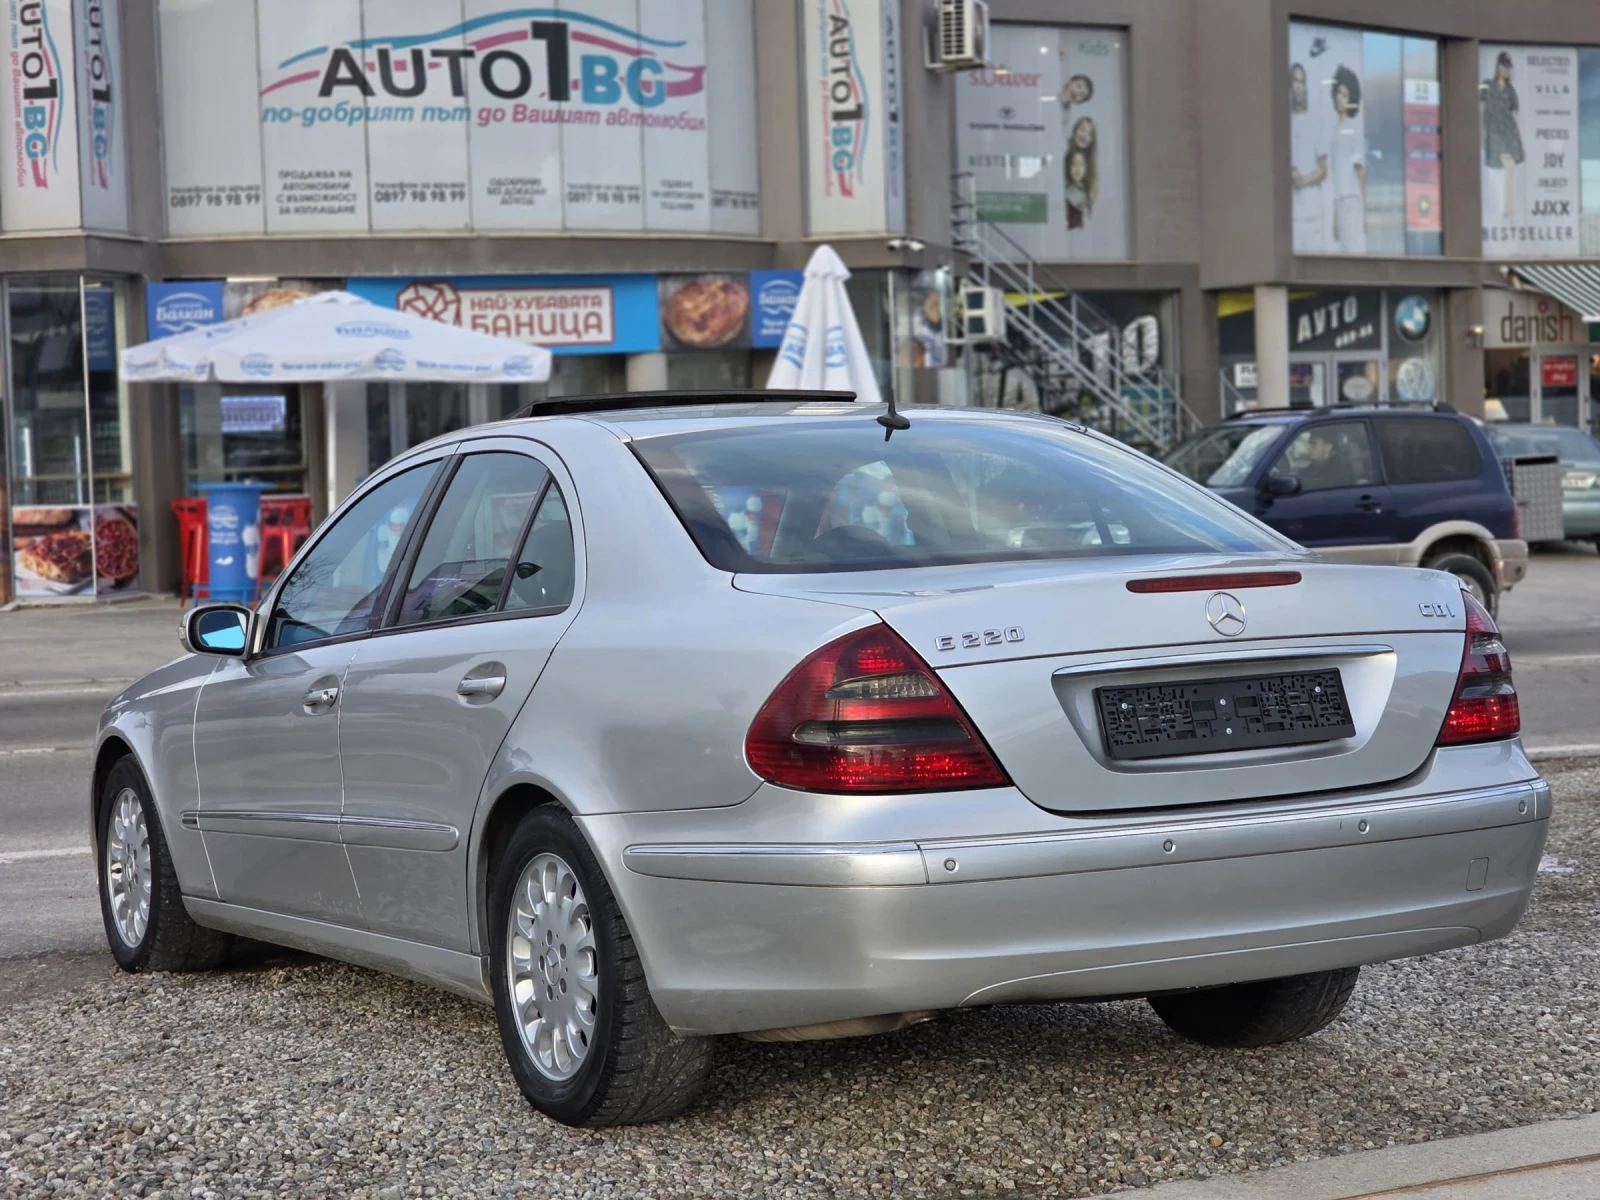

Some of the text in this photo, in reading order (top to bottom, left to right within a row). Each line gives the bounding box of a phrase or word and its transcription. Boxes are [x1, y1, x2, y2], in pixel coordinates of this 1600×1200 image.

[1535, 84, 1571, 95] VILA
[262, 102, 414, 127] по-добрият
[421, 106, 471, 122] път
[478, 107, 506, 127] до
[512, 104, 601, 126] Вашият
[375, 189, 407, 202] 0897
[1531, 200, 1571, 217] JJXX
[1481, 226, 1573, 242] BESTSELLER
[470, 293, 603, 310] НАЙ-ХУБАВАТА
[156, 307, 214, 321] Балкан
[1501, 301, 1574, 343] danish
[470, 311, 604, 340] БАНИЦА
[1419, 603, 1456, 618] CDI
[934, 626, 1025, 652] E 220
